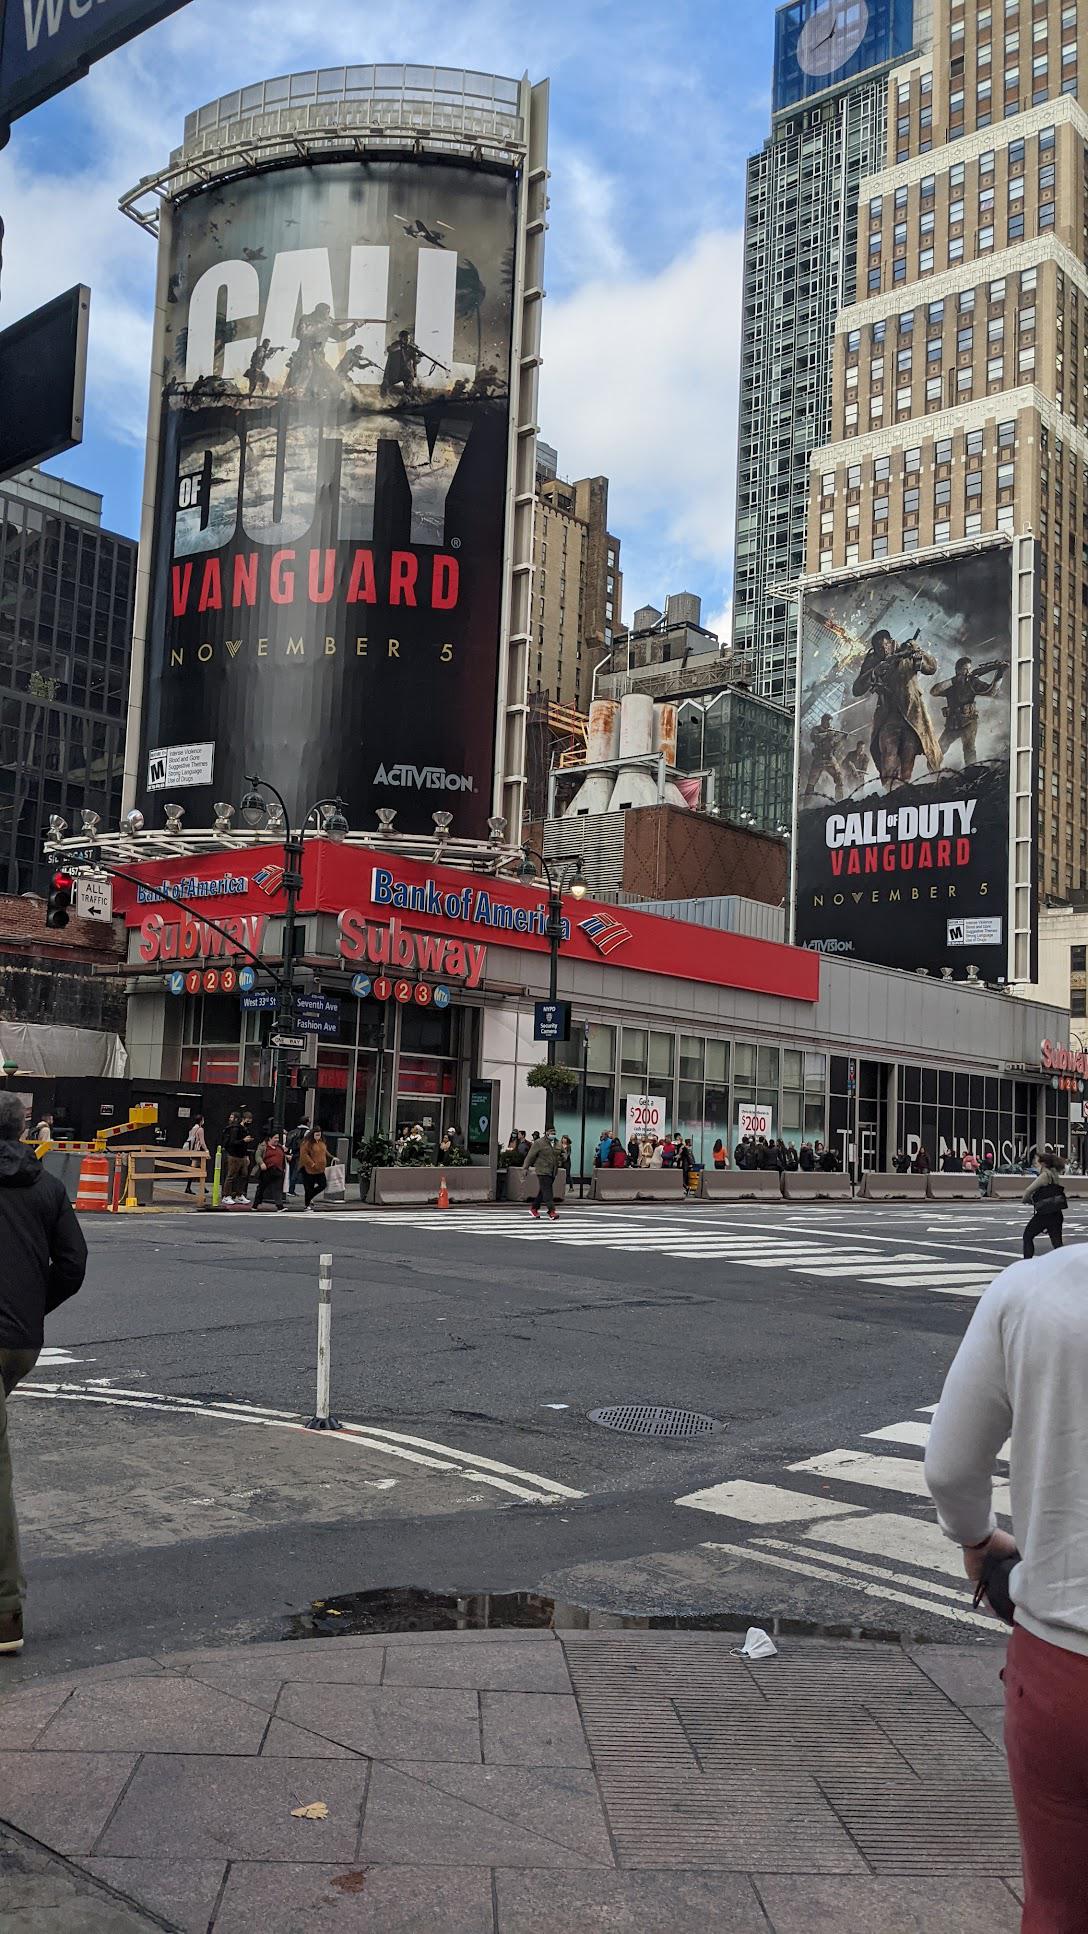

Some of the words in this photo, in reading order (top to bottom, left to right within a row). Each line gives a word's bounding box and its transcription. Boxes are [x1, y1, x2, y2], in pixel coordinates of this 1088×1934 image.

[185, 245, 476, 386] CALL
[173, 413, 474, 559] DUTY
[179, 474, 202, 508] OF
[172, 548, 460, 617] VANGUARD
[170, 637, 400, 667] NOVEMBER
[440, 644, 453, 662] 5
[151, 760, 165, 782] M
[373, 762, 473, 792] ACTIVISION
[825, 809, 891, 849] CALL
[887, 813, 899, 828] OF
[898, 799, 978, 840] DUTY
[830, 837, 970, 876] VANGUARD
[82, 894, 108, 905] TRAFFIC
[86, 884, 103, 894] ALL
[137, 880, 170, 903] Bank
[172, 876, 187, 899] of
[187, 873, 249, 897] America
[813, 886, 956, 906] NOVEMBER
[979, 883, 988, 895] 5
[370, 867, 442, 916] Bank
[445, 888, 472, 921] of
[474, 890, 571, 941] Ameria
[139, 912, 268, 964] Subway
[950, 926, 962, 940] M
[336, 909, 487, 988] Subway
[244, 998, 258, 1007] West
[259, 997, 269, 1007] 33rd
[270, 997, 276, 1006] St
[297, 998, 324, 1010] Seventh
[325, 1002, 338, 1012] Ave
[297, 1018, 322, 1031] Fashion
[323, 1022, 336, 1032] Ave
[540, 1022, 558, 1030] Security
[630, 1106, 659, 1125] $200
[742, 1115, 766, 1132] $200
